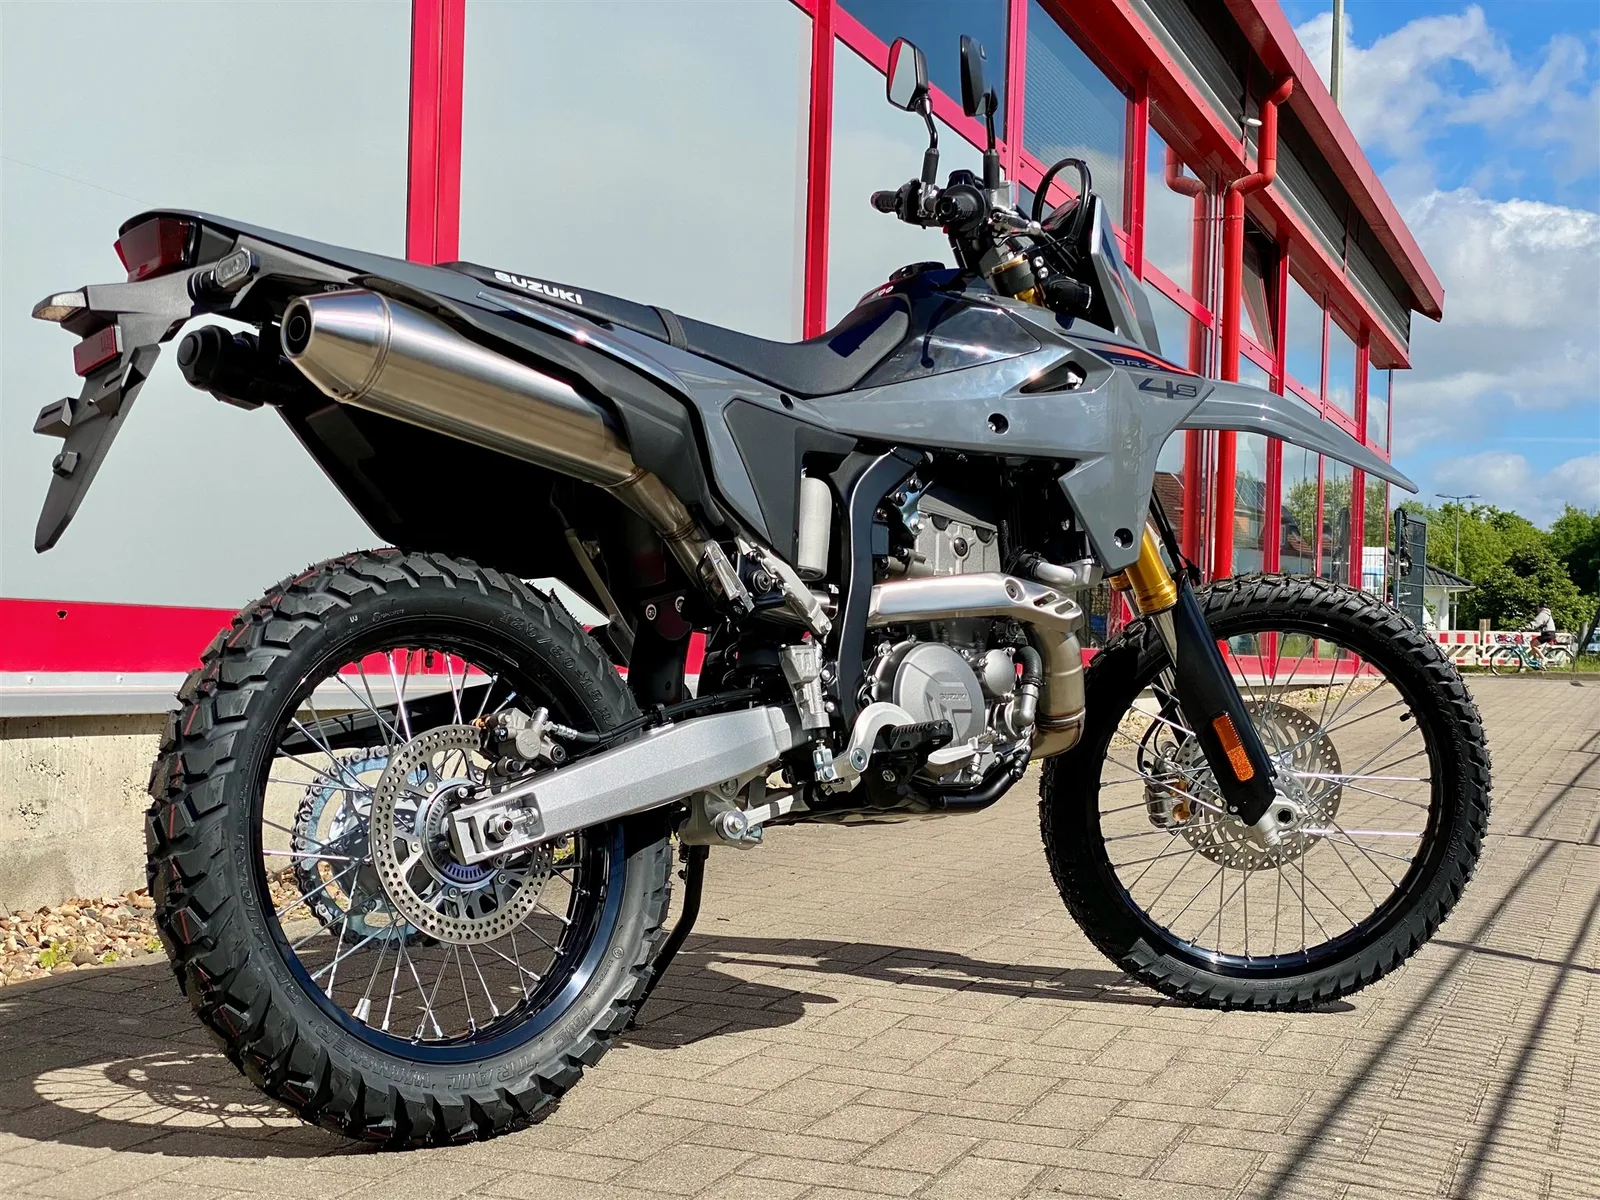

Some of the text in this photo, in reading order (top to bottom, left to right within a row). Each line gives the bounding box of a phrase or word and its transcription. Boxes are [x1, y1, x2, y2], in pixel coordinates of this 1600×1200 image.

[494, 271, 583, 305] SUZUKI
[1112, 358, 1160, 371] DR-Z
[315, 1023, 431, 1088] WINNER
[445, 1054, 541, 1090] TRAIL
